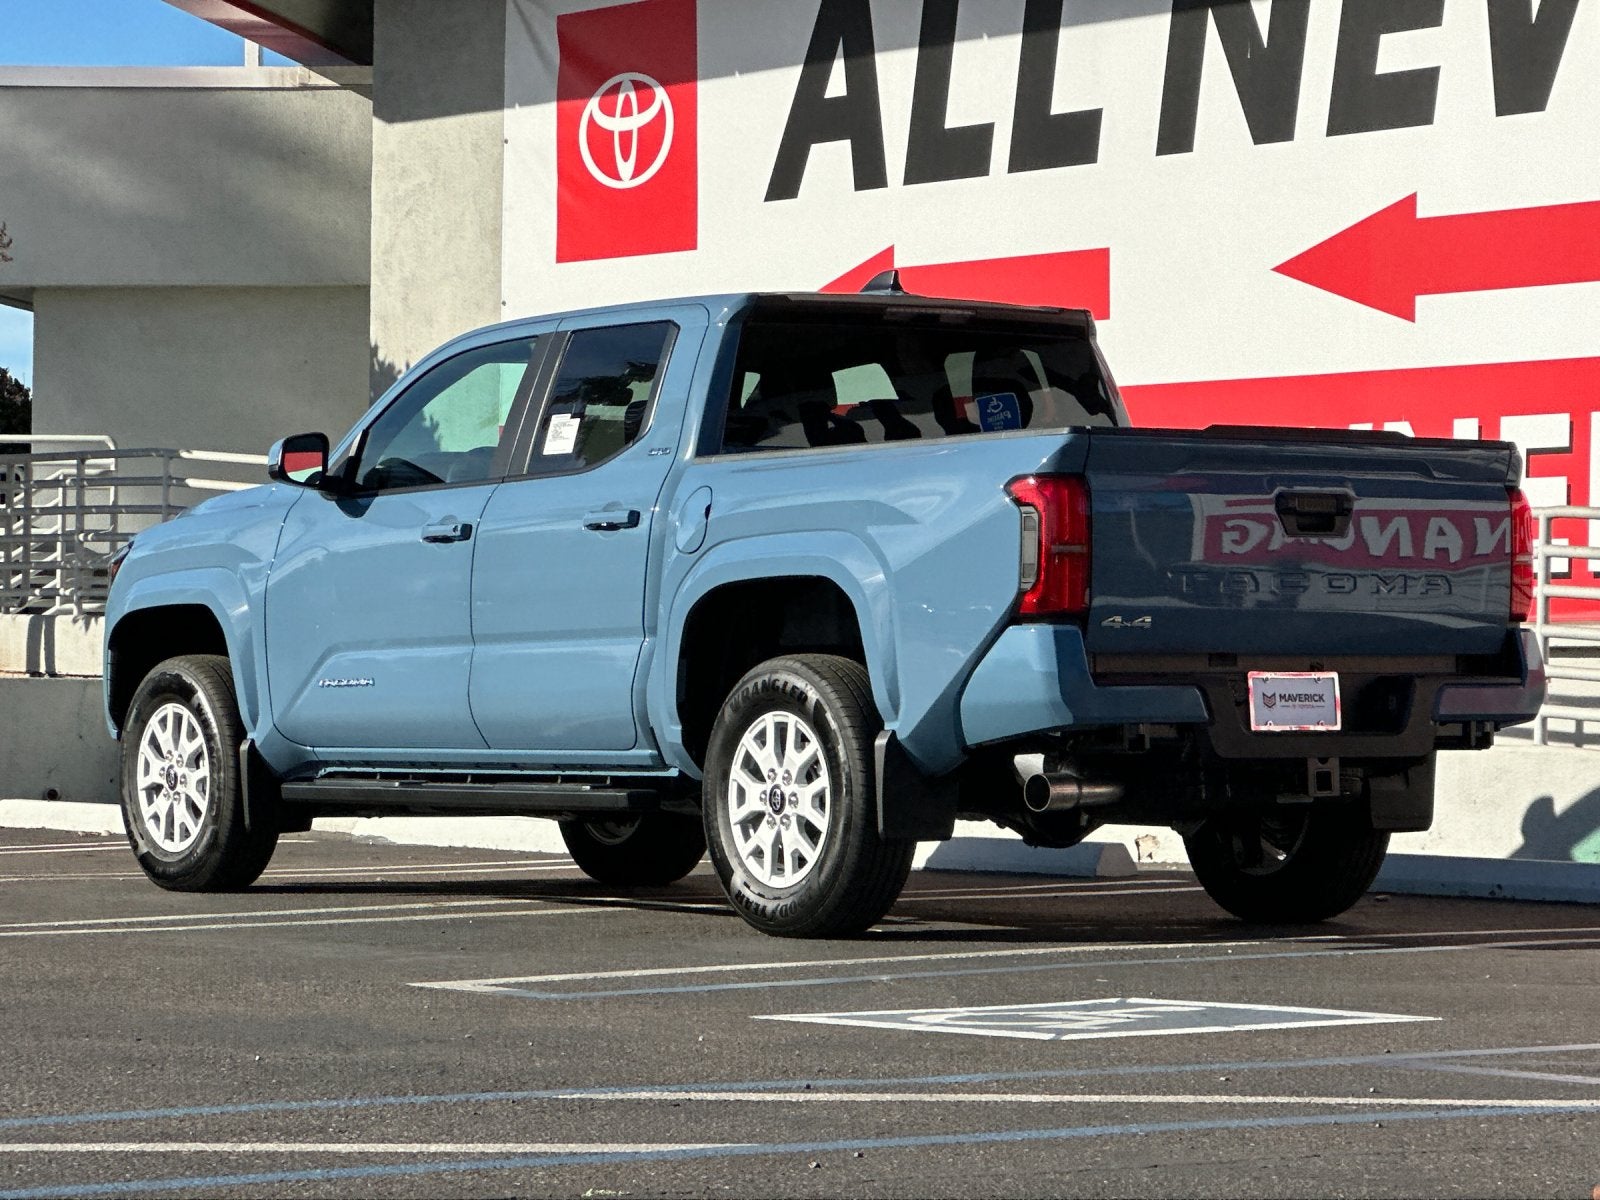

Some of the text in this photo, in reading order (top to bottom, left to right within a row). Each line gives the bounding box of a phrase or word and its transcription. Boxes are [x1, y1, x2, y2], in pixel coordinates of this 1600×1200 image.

[764, 0, 1103, 202] ALL
[1167, 570, 1454, 596] TACOMA
[1279, 693, 1326, 703] MAVERICK
